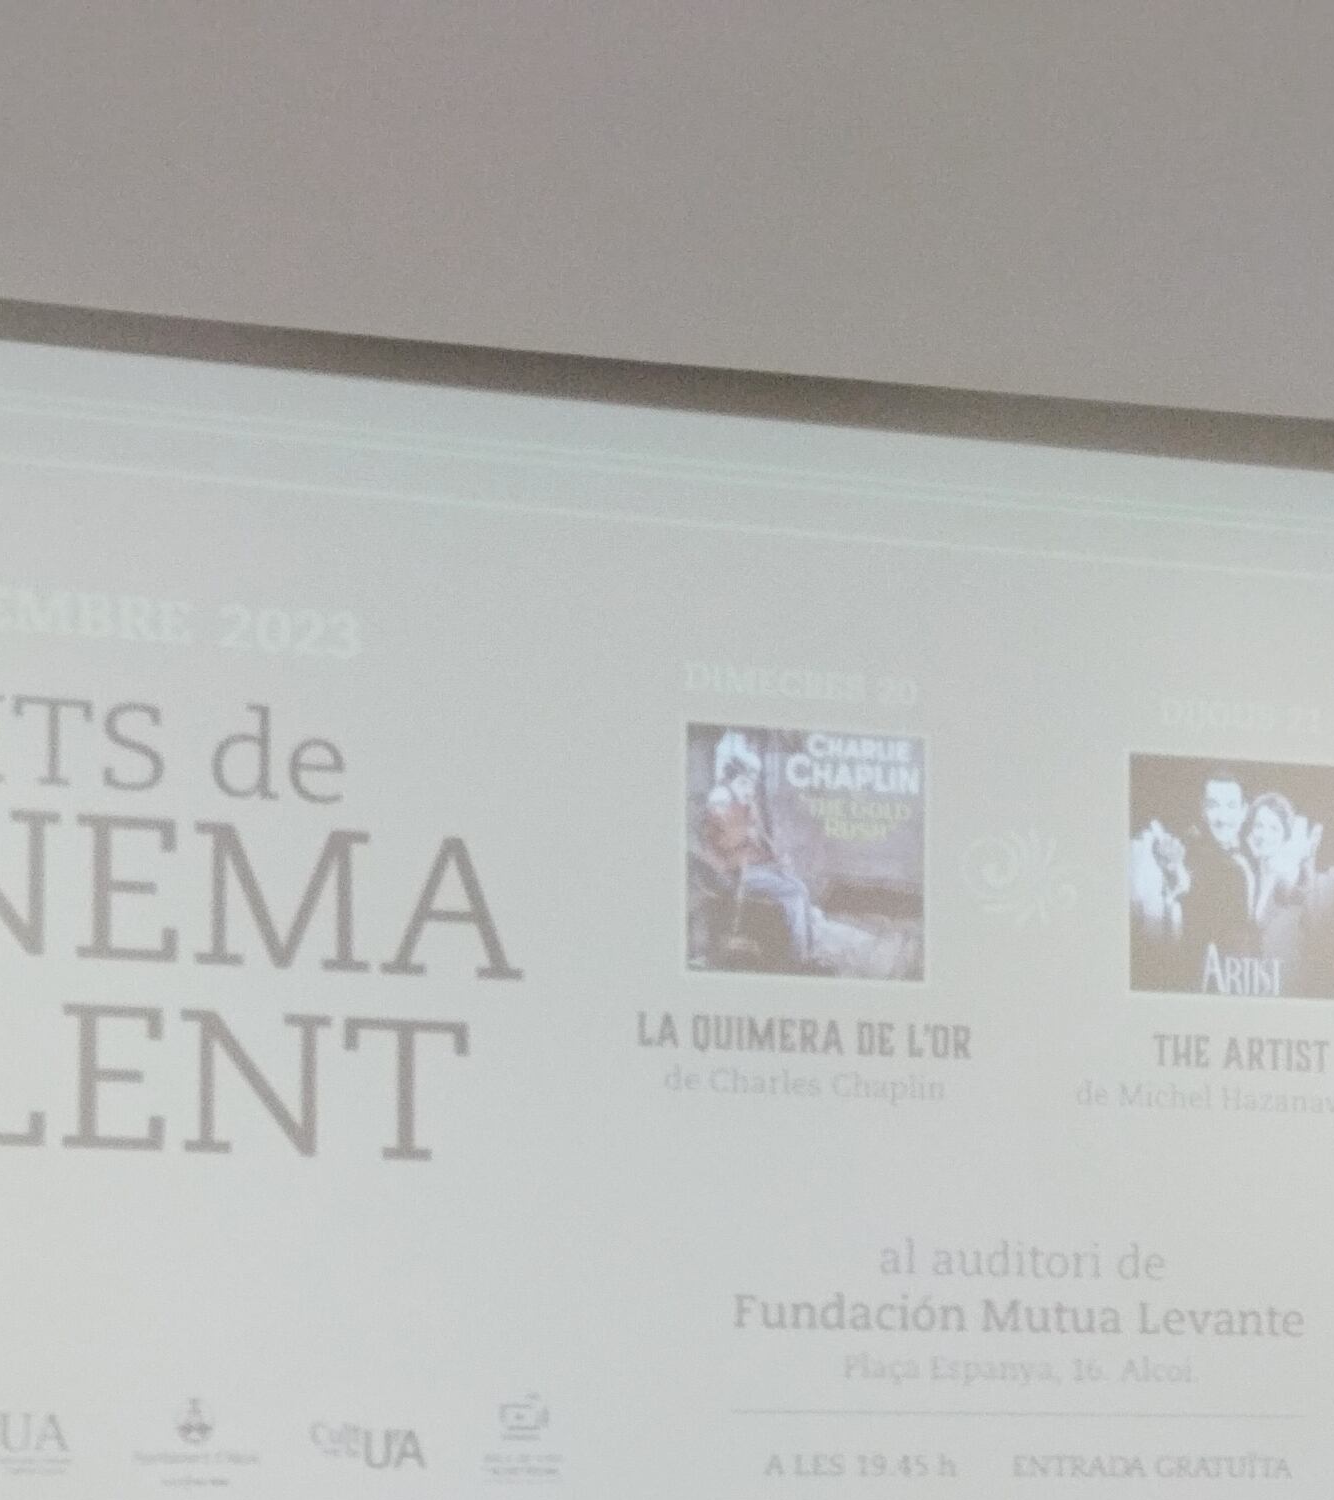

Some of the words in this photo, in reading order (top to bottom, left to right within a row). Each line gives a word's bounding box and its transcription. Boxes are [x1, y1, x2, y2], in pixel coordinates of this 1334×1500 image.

[217, 602, 364, 660] 2023
[210, 702, 347, 805] de
[785, 752, 920, 795] CHAPLIN
[636, 1010, 680, 1049] LA
[691, 1013, 845, 1056] QUIMERA
[856, 1018, 896, 1058] DE
[907, 1022, 973, 1060] L'OR
[1152, 1031, 1211, 1069] THE
[1222, 1035, 1331, 1074] ARTIST
[663, 1063, 702, 1093] de
[708, 1066, 823, 1098] Charles
[830, 1071, 947, 1107] Chaplin
[1074, 1078, 1110, 1107] de
[1118, 1080, 1212, 1111] Michel
[878, 1236, 917, 1277] al
[930, 1238, 1104, 1280] auditori
[1115, 1241, 1167, 1282] de
[731, 1290, 970, 1333] Fundación
[979, 1297, 1125, 1336] Mutua
[1137, 1300, 1307, 1339] Levante
[842, 1353, 921, 1388] Plaça
[763, 1453, 786, 1479] A
[792, 1453, 848, 1479] LES
[855, 1453, 931, 1479] 19.45
[936, 1454, 959, 1479] h
[1011, 1452, 1148, 1480] ENTRADA
